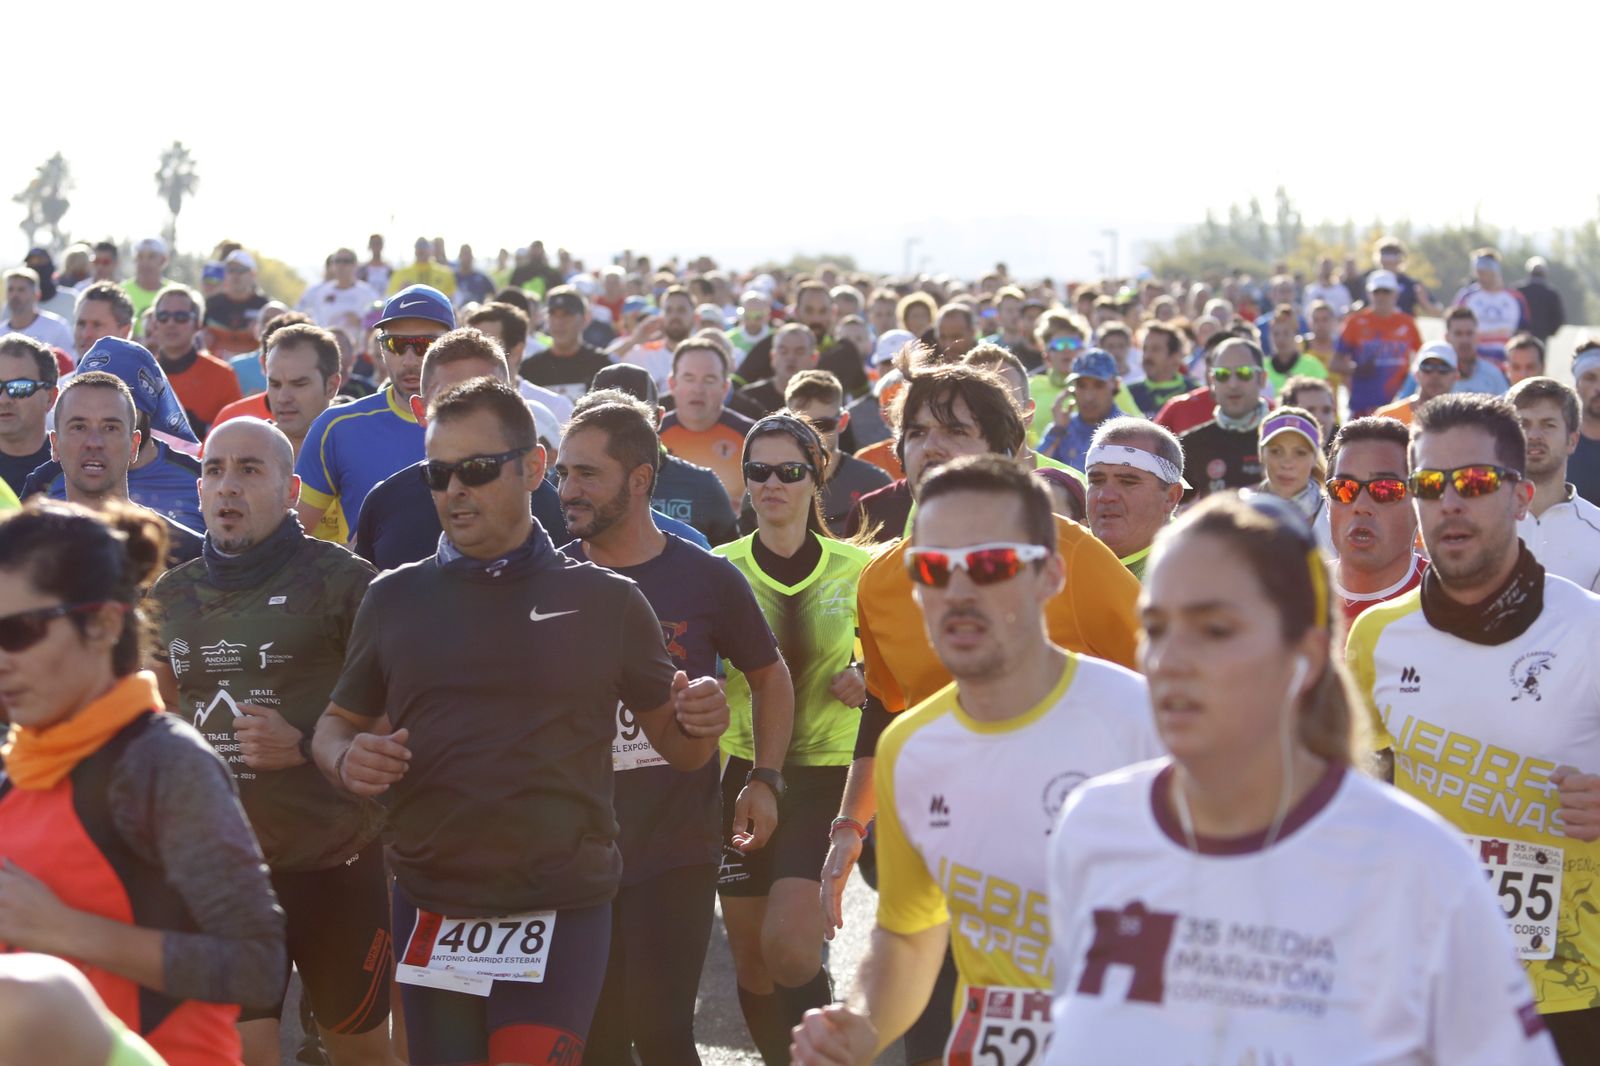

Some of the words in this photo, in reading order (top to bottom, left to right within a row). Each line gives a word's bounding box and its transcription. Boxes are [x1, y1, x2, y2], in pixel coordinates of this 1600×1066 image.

[207, 733, 231, 741] TRAIL
[1483, 868, 1555, 922] 55
[437, 919, 546, 956] 4078
[1513, 924, 1552, 937] COBOS
[1227, 922, 1338, 965] MEDIA
[431, 954, 466, 963] ANTONIO
[467, 955, 503, 965] GARRIDO
[504, 956, 542, 965] ESTEBAN
